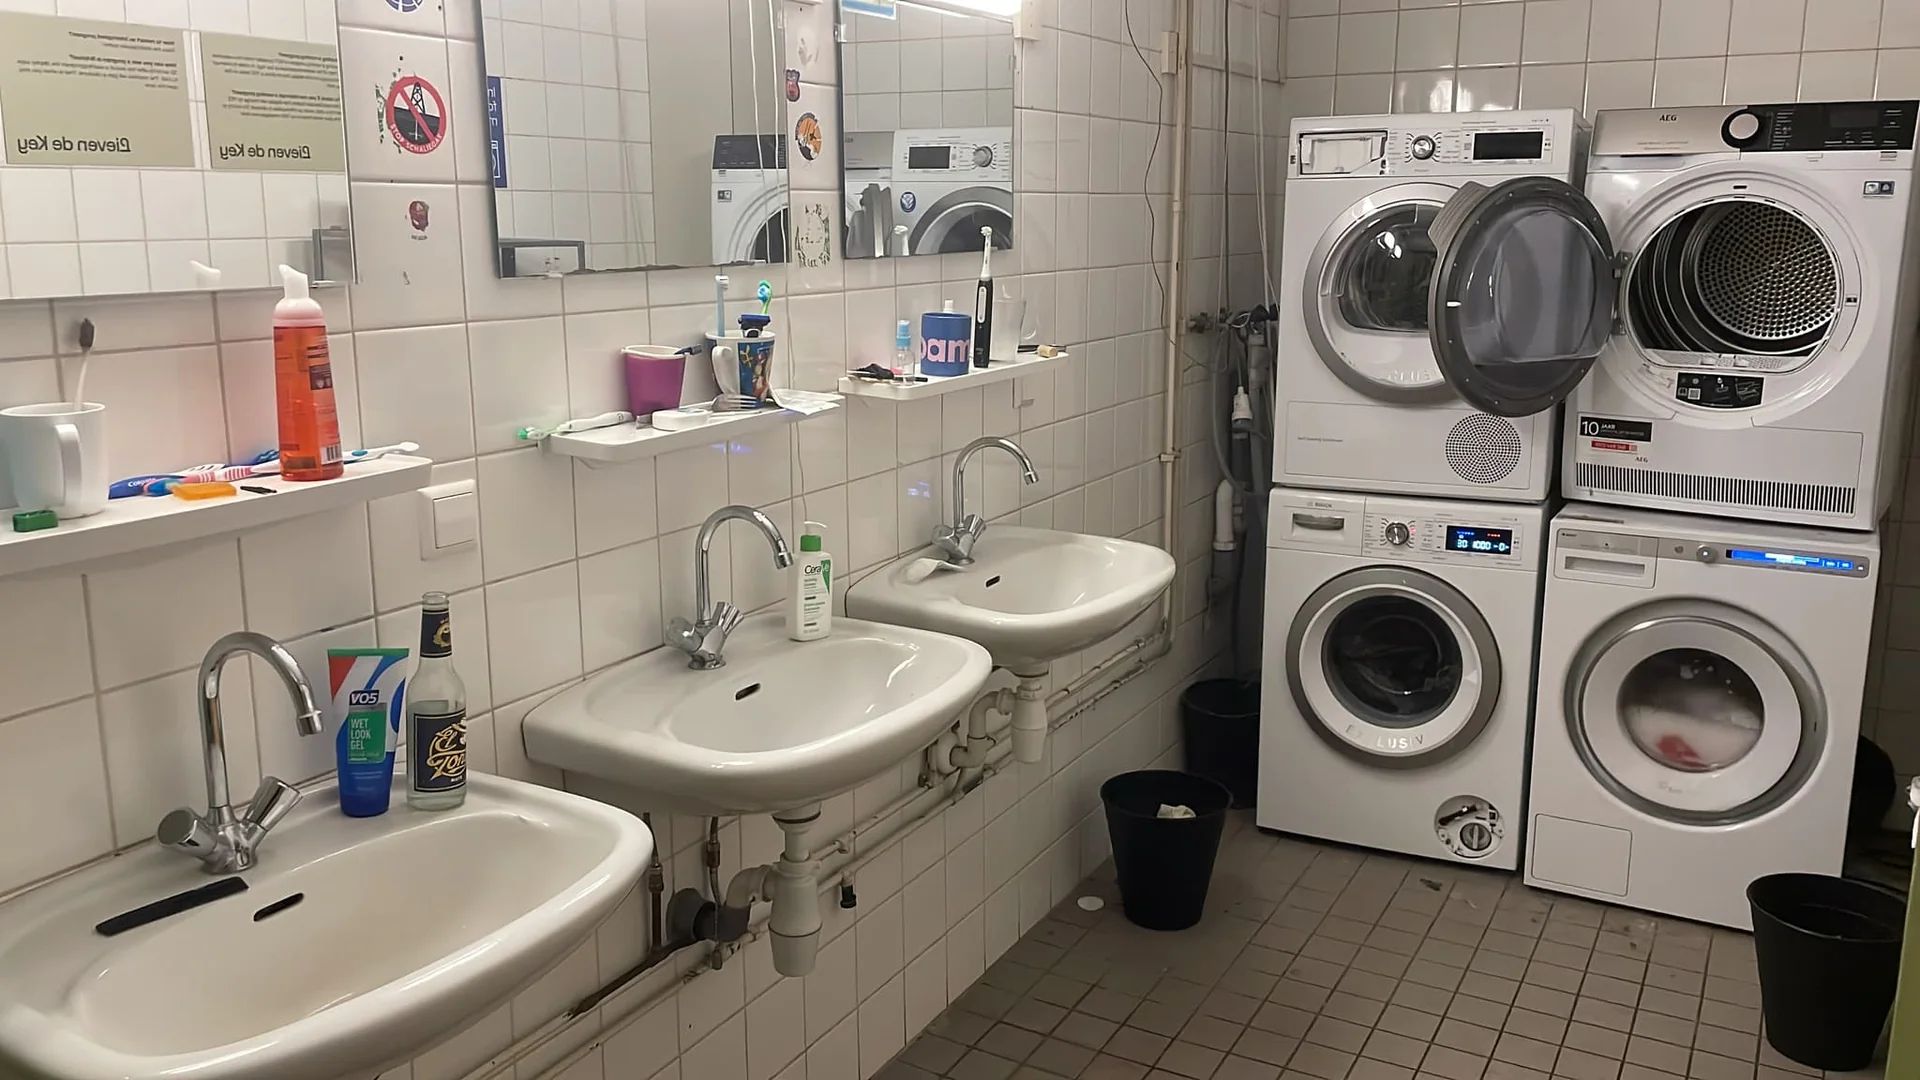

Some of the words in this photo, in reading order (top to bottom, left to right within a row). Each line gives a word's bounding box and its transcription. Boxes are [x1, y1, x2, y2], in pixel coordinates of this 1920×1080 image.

[1659, 114, 1677, 122] AEG
[390, 123, 405, 143] STOP
[1581, 420, 1600, 436] 10
[351, 692, 378, 704] VO5
[350, 718, 369, 729] WET
[350, 729, 372, 740] LOOK
[435, 729, 457, 752] El
[350, 740, 365, 750] GEL
[426, 749, 467, 781] Ton
